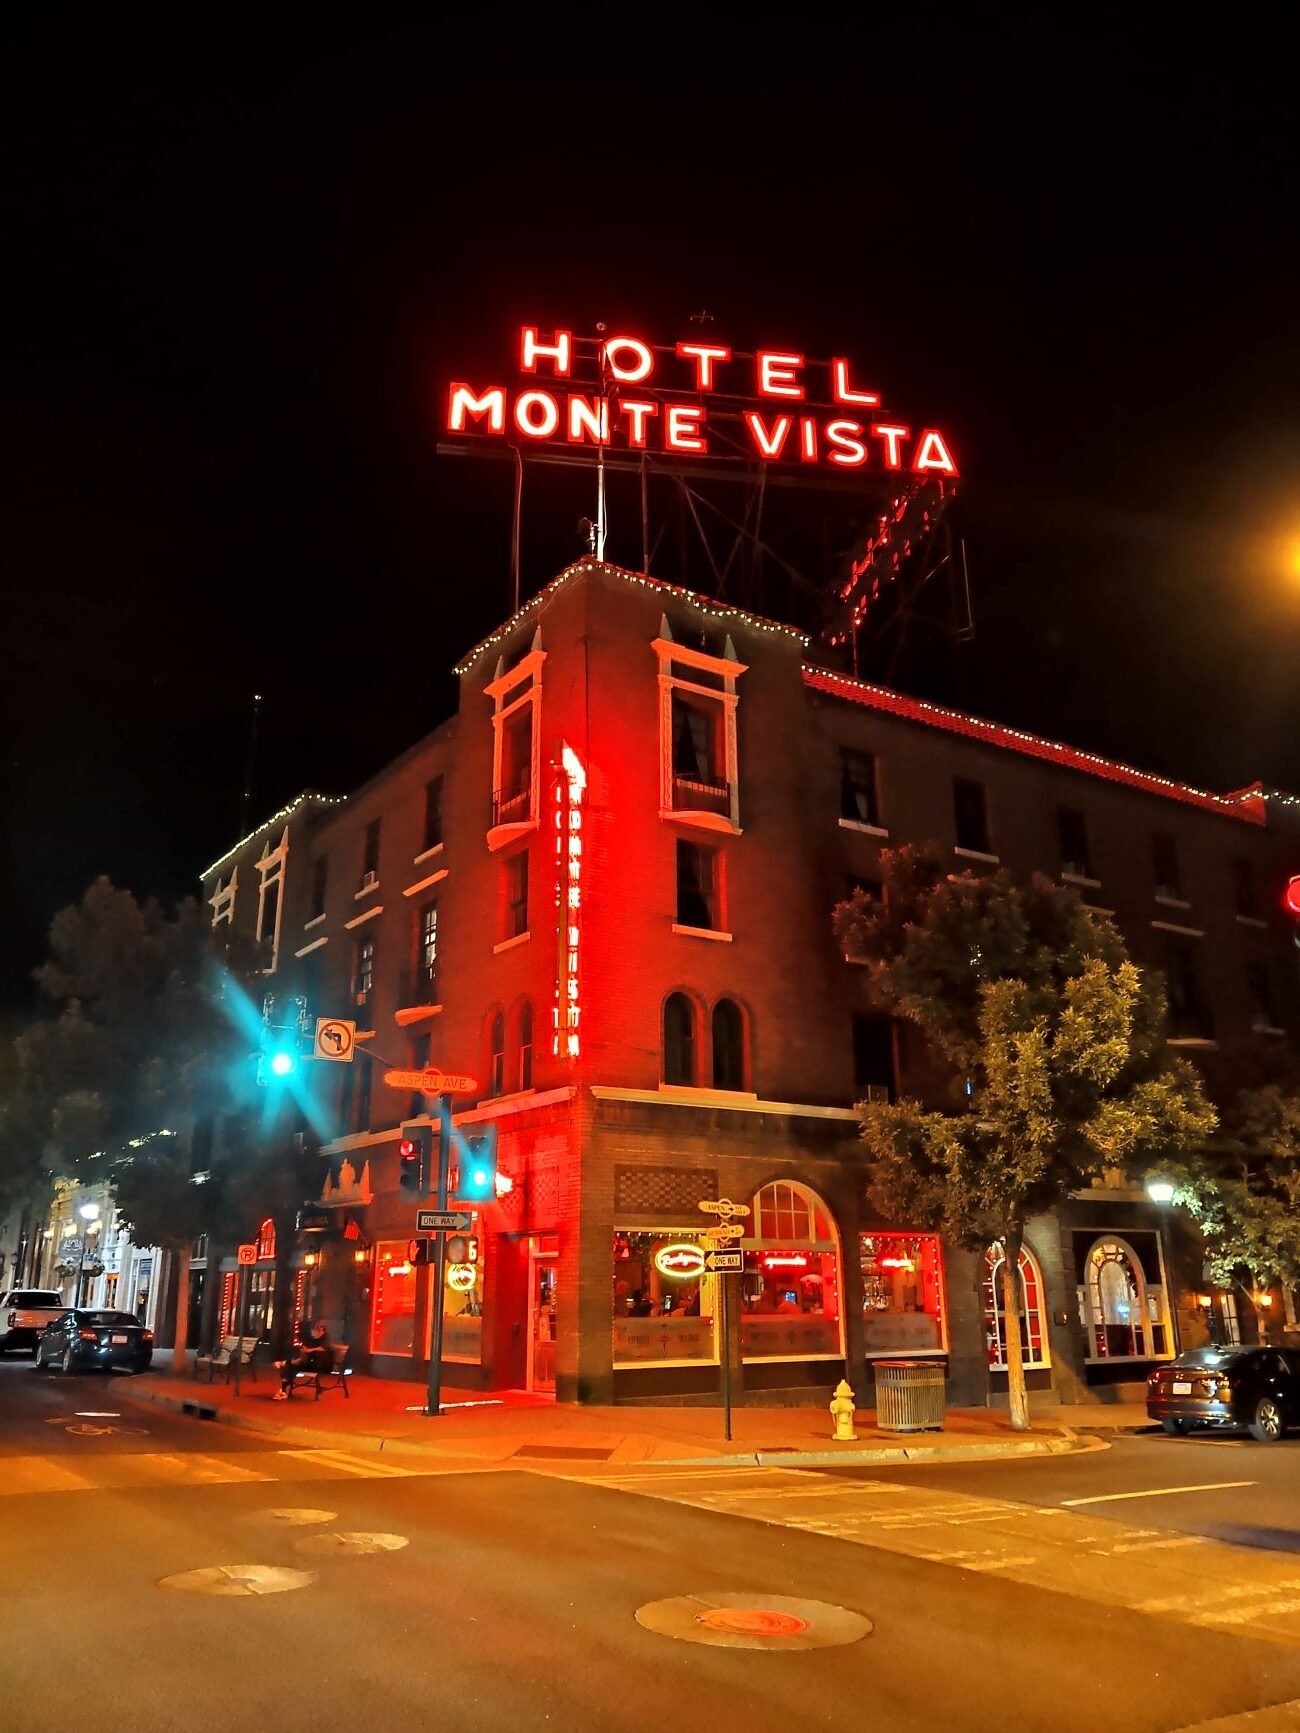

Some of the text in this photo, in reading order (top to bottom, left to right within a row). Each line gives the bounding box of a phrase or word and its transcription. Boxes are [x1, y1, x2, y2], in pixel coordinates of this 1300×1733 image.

[520, 325, 882, 408] HOTEL
[447, 381, 960, 477] MONTE VISTA
[398, 1074, 467, 1090] ASPEN AVE
[423, 1216, 456, 1225] ONE WAY
[715, 1255, 739, 1265] ONE WAY
